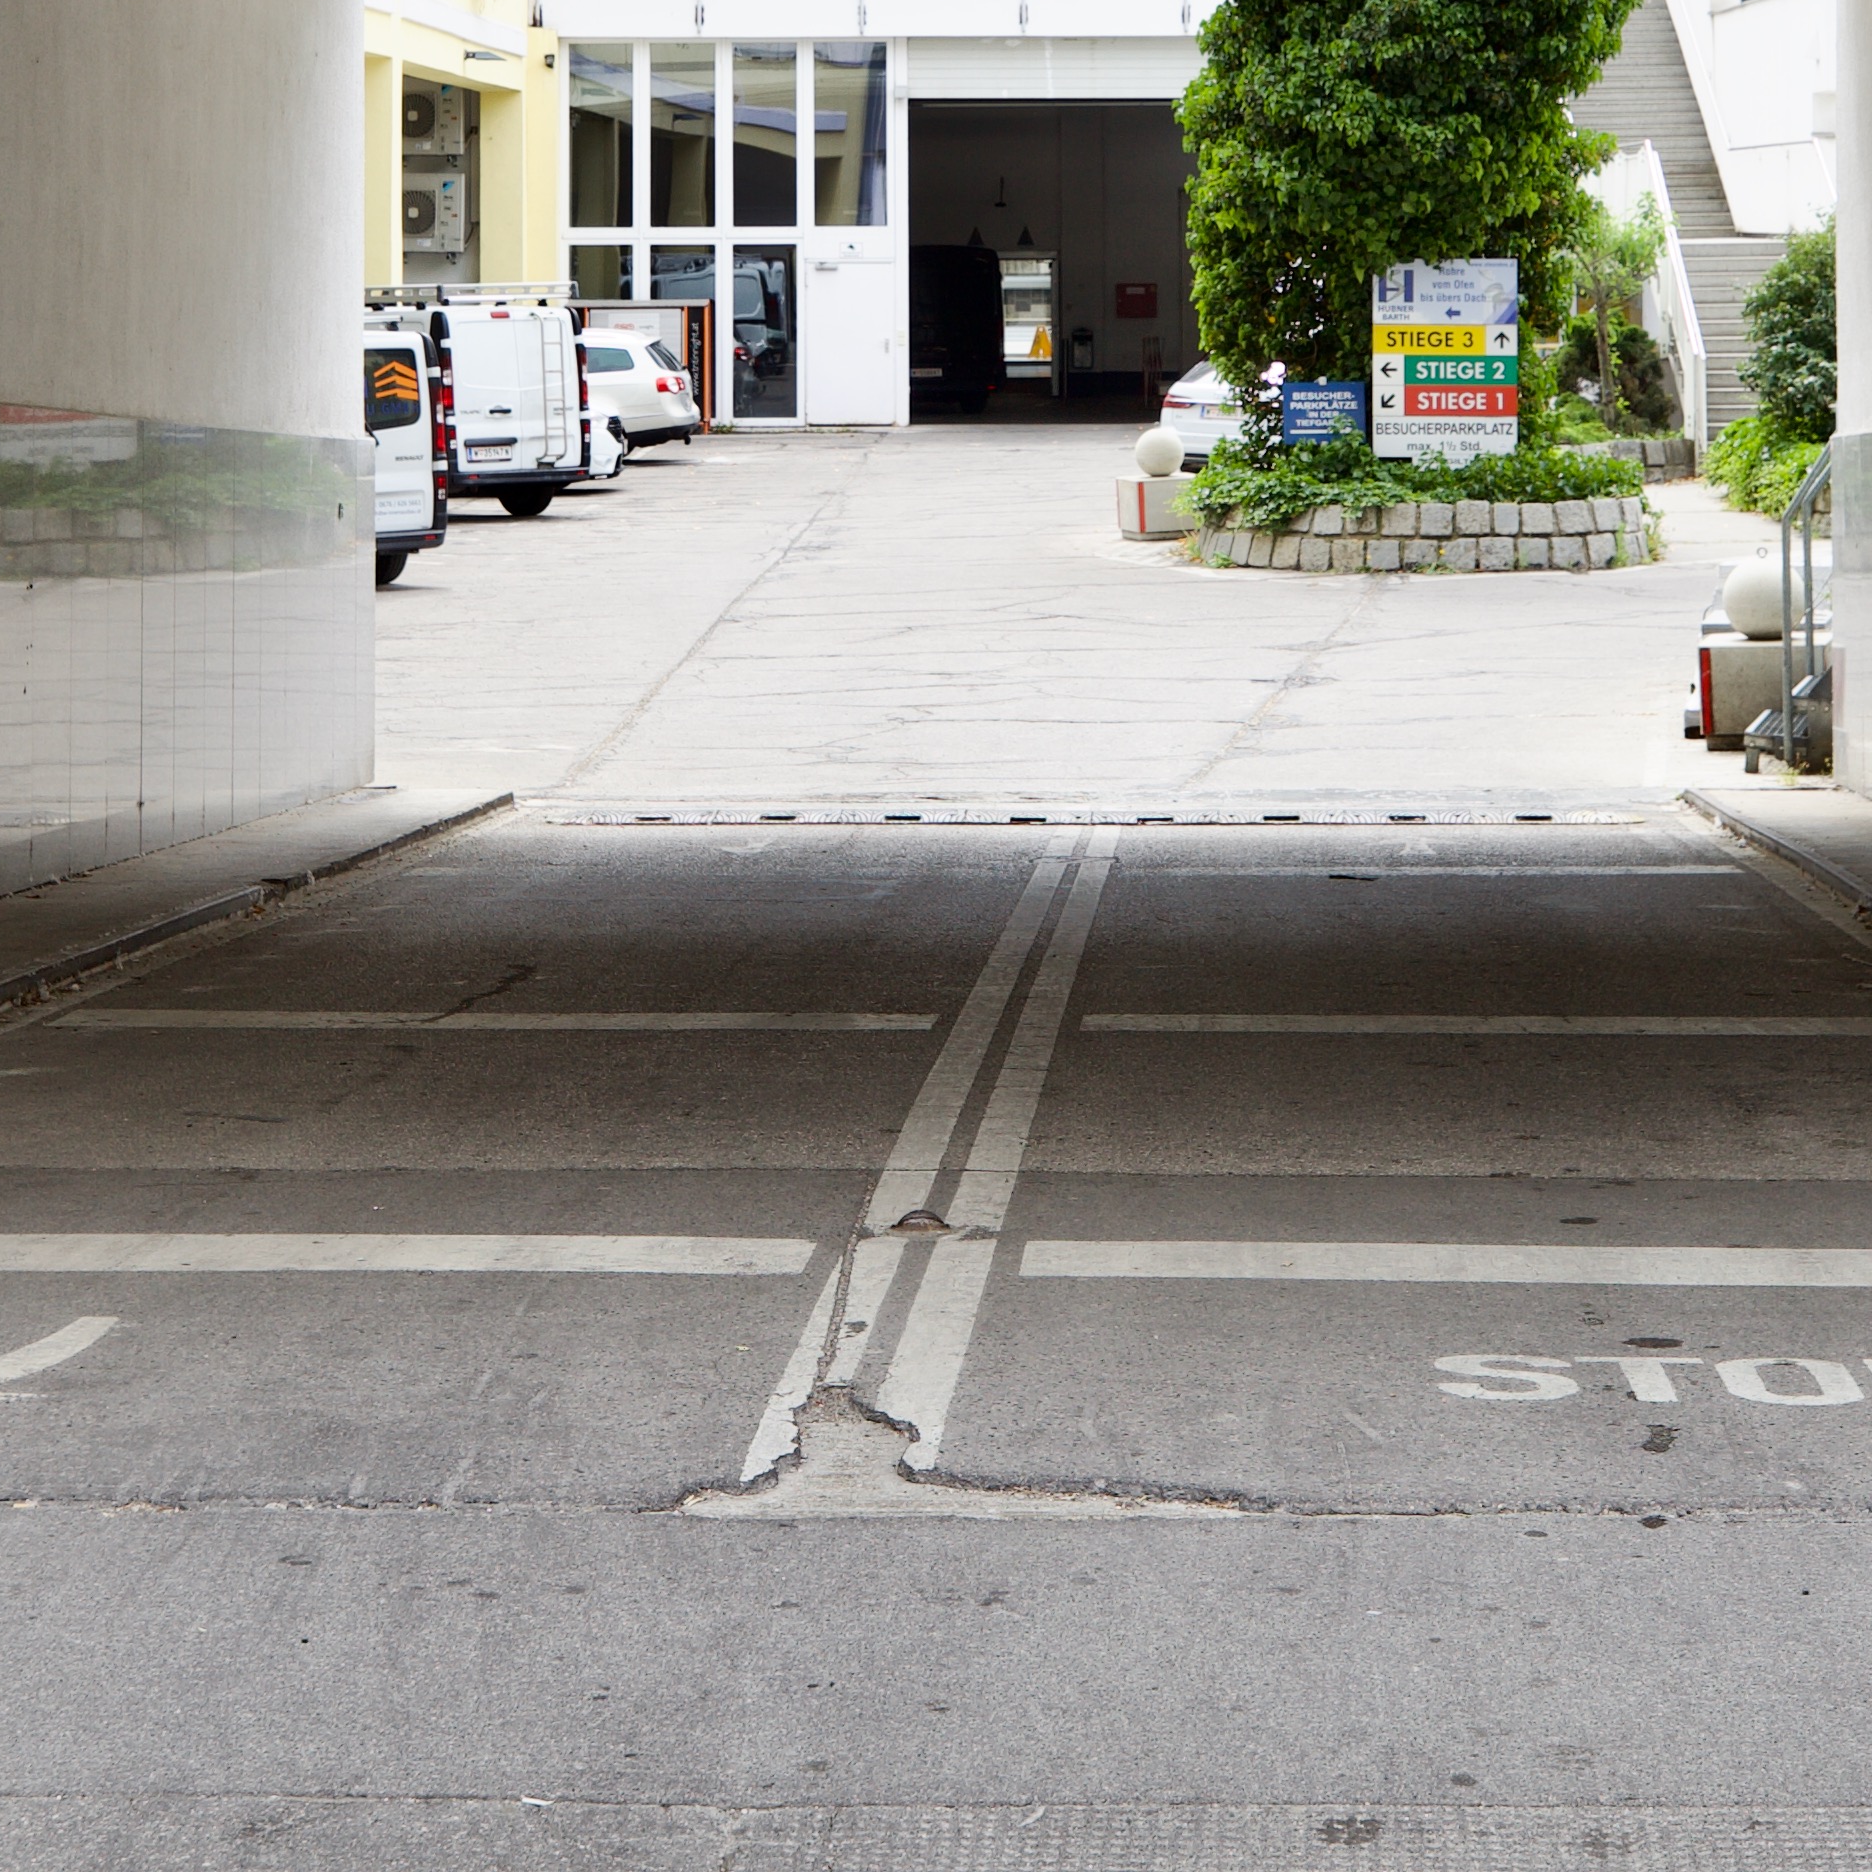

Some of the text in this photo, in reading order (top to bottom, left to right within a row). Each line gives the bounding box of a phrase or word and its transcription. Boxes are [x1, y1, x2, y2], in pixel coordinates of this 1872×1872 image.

[1432, 281, 1451, 289] vom
[1420, 292, 1487, 303] bis übers Dach
[1383, 313, 1410, 321] BARTH
[1386, 331, 1474, 347] STIEGE 3
[1415, 361, 1505, 380] STIEGE 2
[1292, 391, 1355, 401] BESUCHER-
[1417, 392, 1504, 410] STIEGE 1
[1290, 400, 1358, 410] PARKPLÄTZE
[1375, 423, 1514, 435] BESUCHERPARKPLATZ
[1460, 441, 1482, 451] Std.
